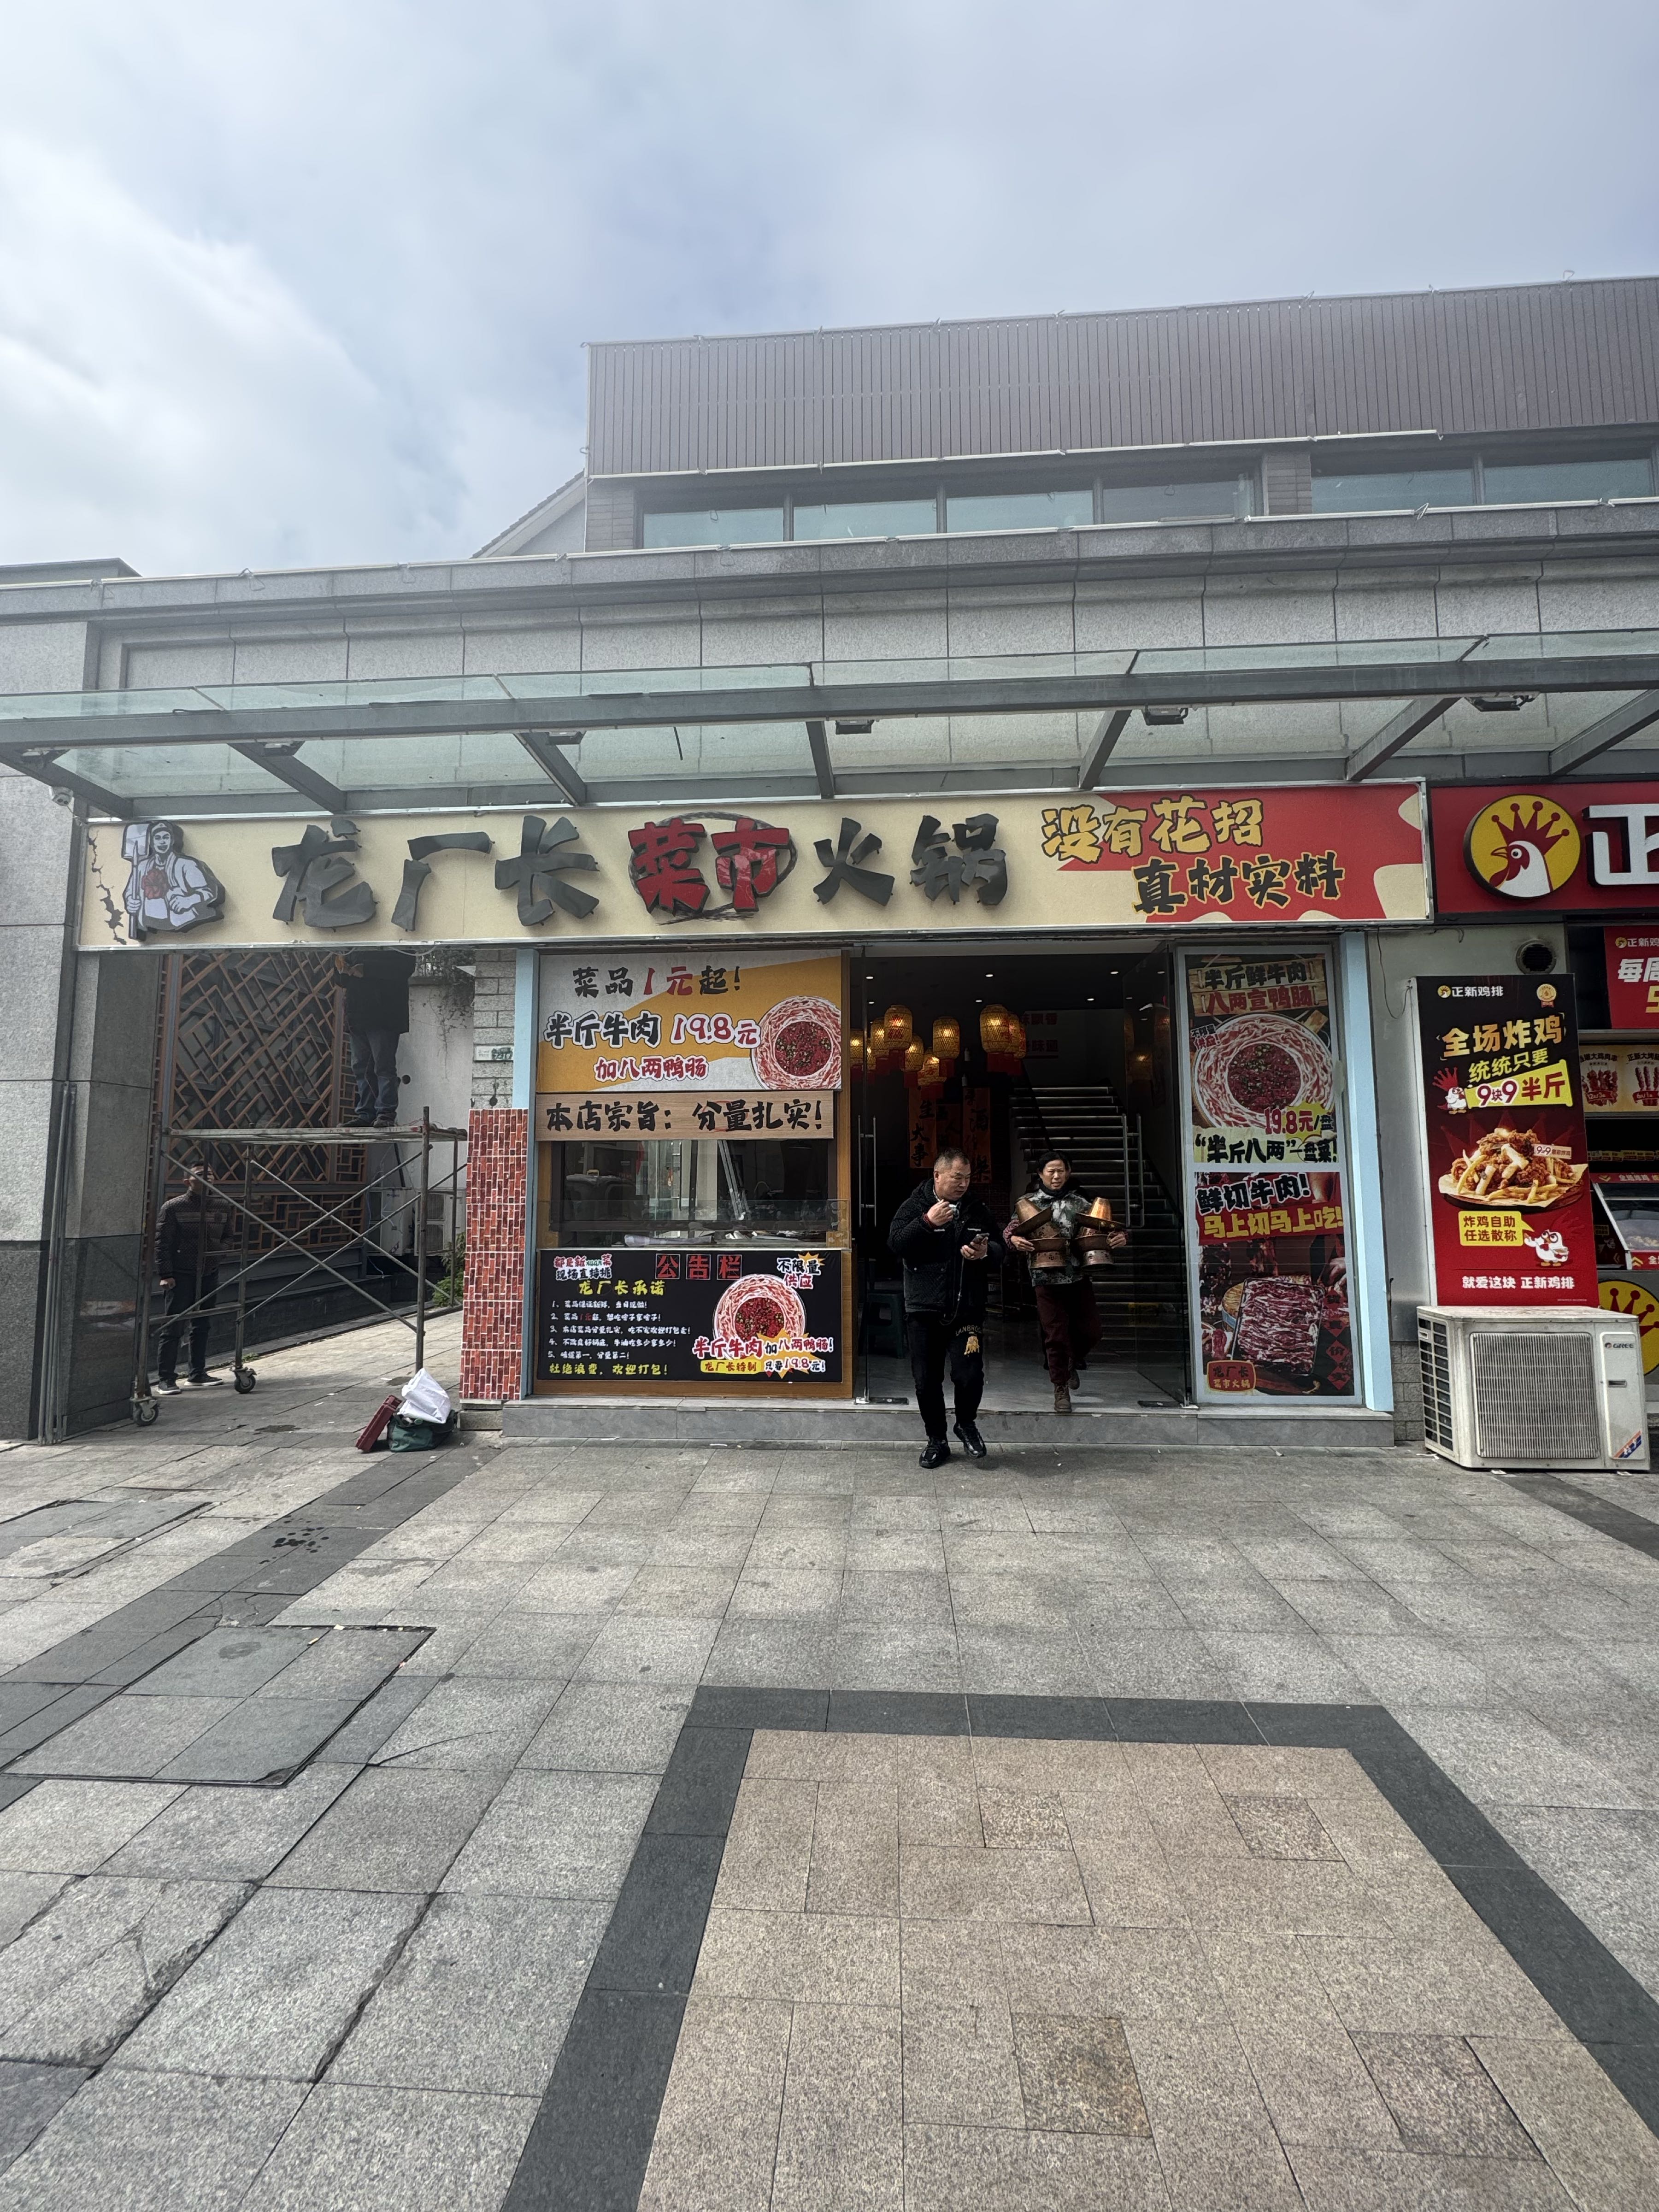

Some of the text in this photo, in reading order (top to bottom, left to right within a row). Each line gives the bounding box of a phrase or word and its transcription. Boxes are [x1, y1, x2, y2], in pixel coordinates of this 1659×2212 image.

[1041, 795, 1264, 863] 没有花招
[1131, 850, 1345, 916] 真材实料
[1205, 962, 1307, 990] 半斤鲜牛肉
[1206, 985, 1313, 1014] 八两宣鸭肠
[1452, 986, 1504, 997] 正新鸡排
[1442, 1015, 1562, 1057] 全场炸鸡
[595, 1055, 708, 1081] 加八两鸭肠
[1469, 1047, 1548, 1083] 统统只要
[1477, 1072, 1565, 1106] 9块9半斤
[1464, 1215, 1515, 1228] 炸鸡自助
[1465, 1230, 1517, 1241] 任选散称
[657, 1254, 741, 1279] 公告栏
[777, 1258, 821, 1275] 不限量
[579, 1280, 665, 1295] 龙厂长承诺
[784, 1274, 813, 1289] 供应
[1462, 1276, 1575, 1289] 就爱这块 正新鸡排
[705, 1361, 757, 1372] 龙厂长特制
[1213, 1366, 1249, 1378] 龙厂长
[1213, 1379, 1250, 1388] 菜市火锅
